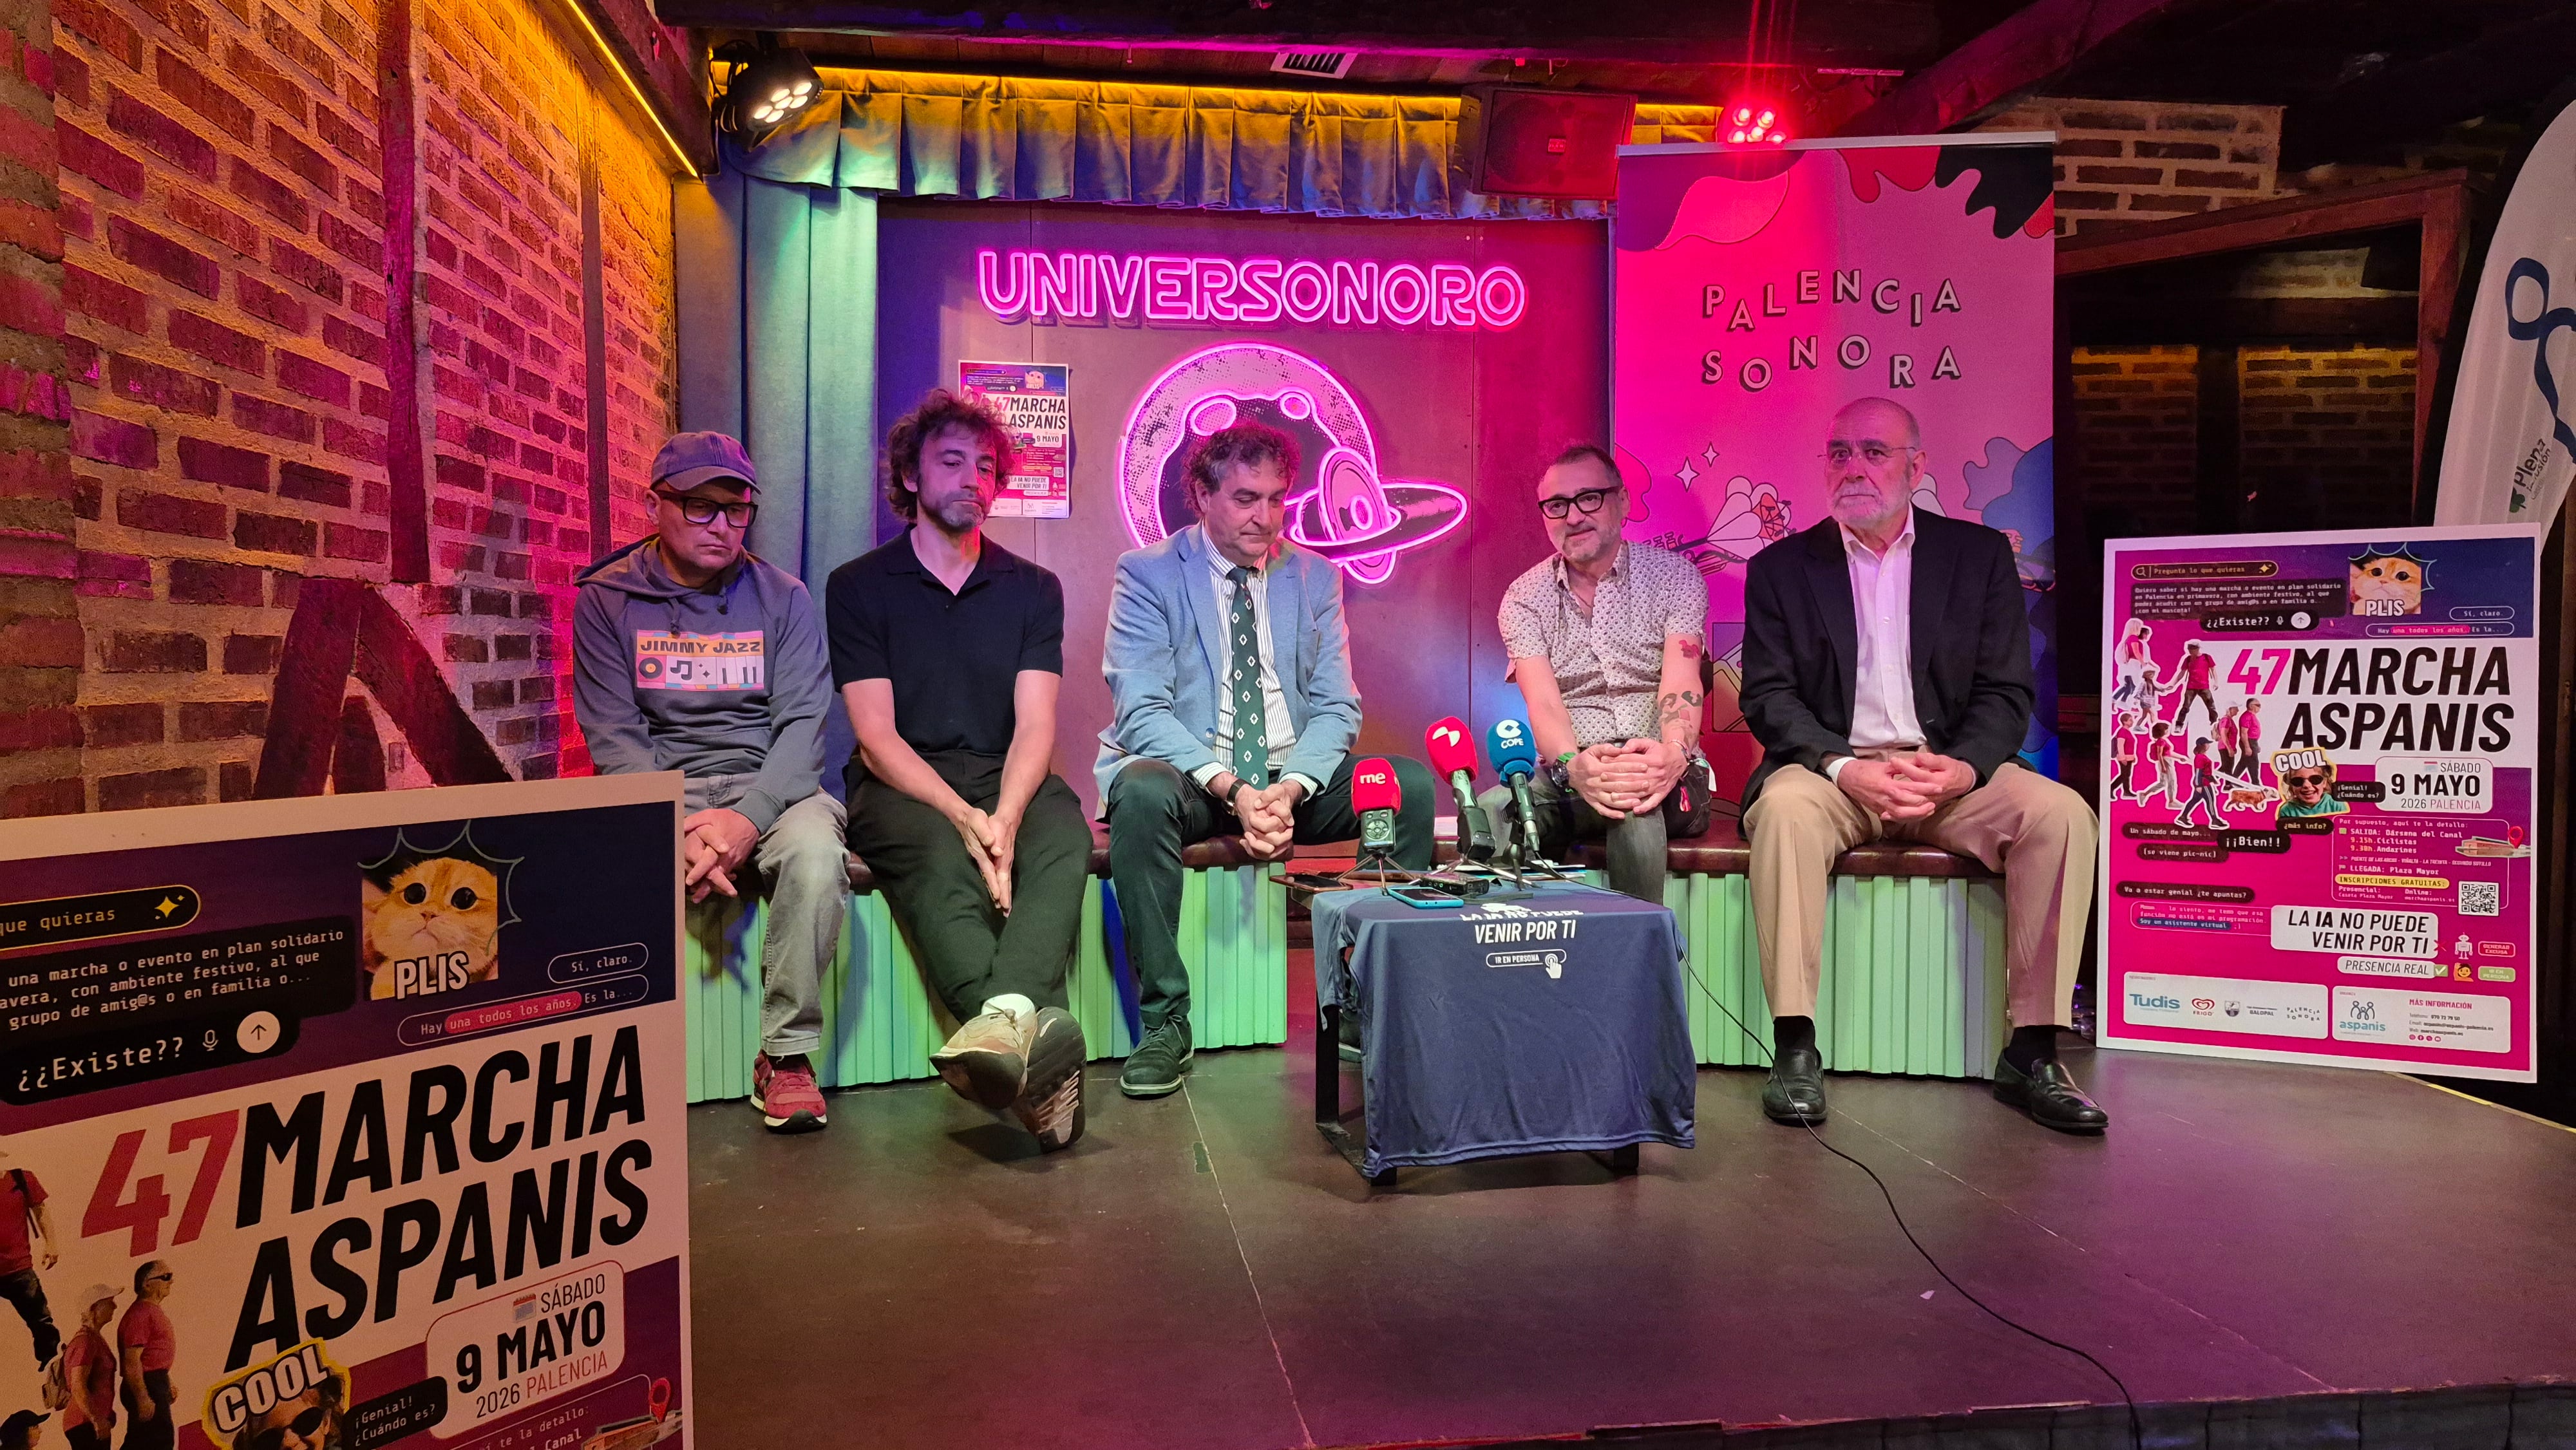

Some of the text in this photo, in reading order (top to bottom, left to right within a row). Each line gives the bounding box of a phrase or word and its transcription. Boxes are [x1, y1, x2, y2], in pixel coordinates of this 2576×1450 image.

[979, 250, 1526, 327] UNIVERSONORO
[1703, 270, 1962, 332] PALENCIA
[1702, 335, 1962, 391] SONORA
[1010, 397, 1065, 413] MARCHA
[1010, 414, 1066, 429] ASPANIS
[2365, 599, 2405, 617] PLIS
[2206, 616, 2270, 628] ¿¿Existe??
[641, 640, 761, 654] JIMMY JAZZ
[2226, 646, 2511, 696] 47 MARCHA
[2280, 702, 2514, 752] ASPANIS
[1501, 739, 1524, 749] COPE
[2275, 750, 2326, 772] COOL
[2440, 760, 2481, 773] SÁBADO
[2391, 773, 2480, 796] 9 MAYO
[2401, 798, 2481, 810] 2026 PALENCIA
[2226, 836, 2280, 849] ¡¡Bien!!
[2340, 876, 2396, 885] INSCRIPCIONES
[41, 910, 115, 930] quieras
[1475, 919, 1576, 944] VENIR POR TI
[2288, 909, 2429, 933] LA IA NO PUEDE
[2313, 932, 2429, 954] VENIR POR TI
[9, 929, 343, 987] una marcha o evento en plan solidario
[571, 956, 632, 973] Sí, claro.
[1512, 954, 1539, 963] PERSONA
[2345, 960, 2429, 975] PRESENCIA REAL
[71, 984, 99, 998] con
[109, 972, 183, 992] ambiente
[194, 961, 261, 980] festivo,
[270, 954, 287, 968] al
[296, 952, 319, 966] que
[395, 950, 469, 1001] PLIS
[9, 1010, 60, 1030] grupo
[71, 1004, 90, 1017] de
[100, 993, 156, 1013] amig@s
[166, 993, 175, 1003] o
[185, 988, 202, 999] en
[212, 977, 270, 995] familia
[2129, 993, 2180, 1009] Tudis
[2425, 1001, 2472, 1010] INFORMACIÓN
[421, 1022, 442, 1035] Hay
[450, 1017, 471, 1030] una
[479, 1009, 512, 1024] todos
[520, 1004, 538, 1016] los
[545, 998, 576, 1012] años.
[585, 993, 596, 1004] Es
[2340, 1020, 2385, 1031] aspanis
[17, 1037, 184, 1092] ¿¿Existe??
[80, 1024, 646, 1256] 47 MARCHA
[222, 1139, 653, 1373] ASPANIS
[540, 1274, 605, 1313] SÁBADO
[456, 1301, 605, 1393] 9 MAYO
[212, 1343, 330, 1433] COOL
[476, 1351, 607, 1418] 2026 PALENCIA
[355, 1395, 412, 1429] ¡Genial!
[355, 1404, 435, 1447] ¿Cuándo es?
[500, 1436, 513, 1449] te
[520, 1428, 533, 1440] la
[540, 1406, 589, 1433] detallo:
[546, 1429, 582, 1450] Canal
